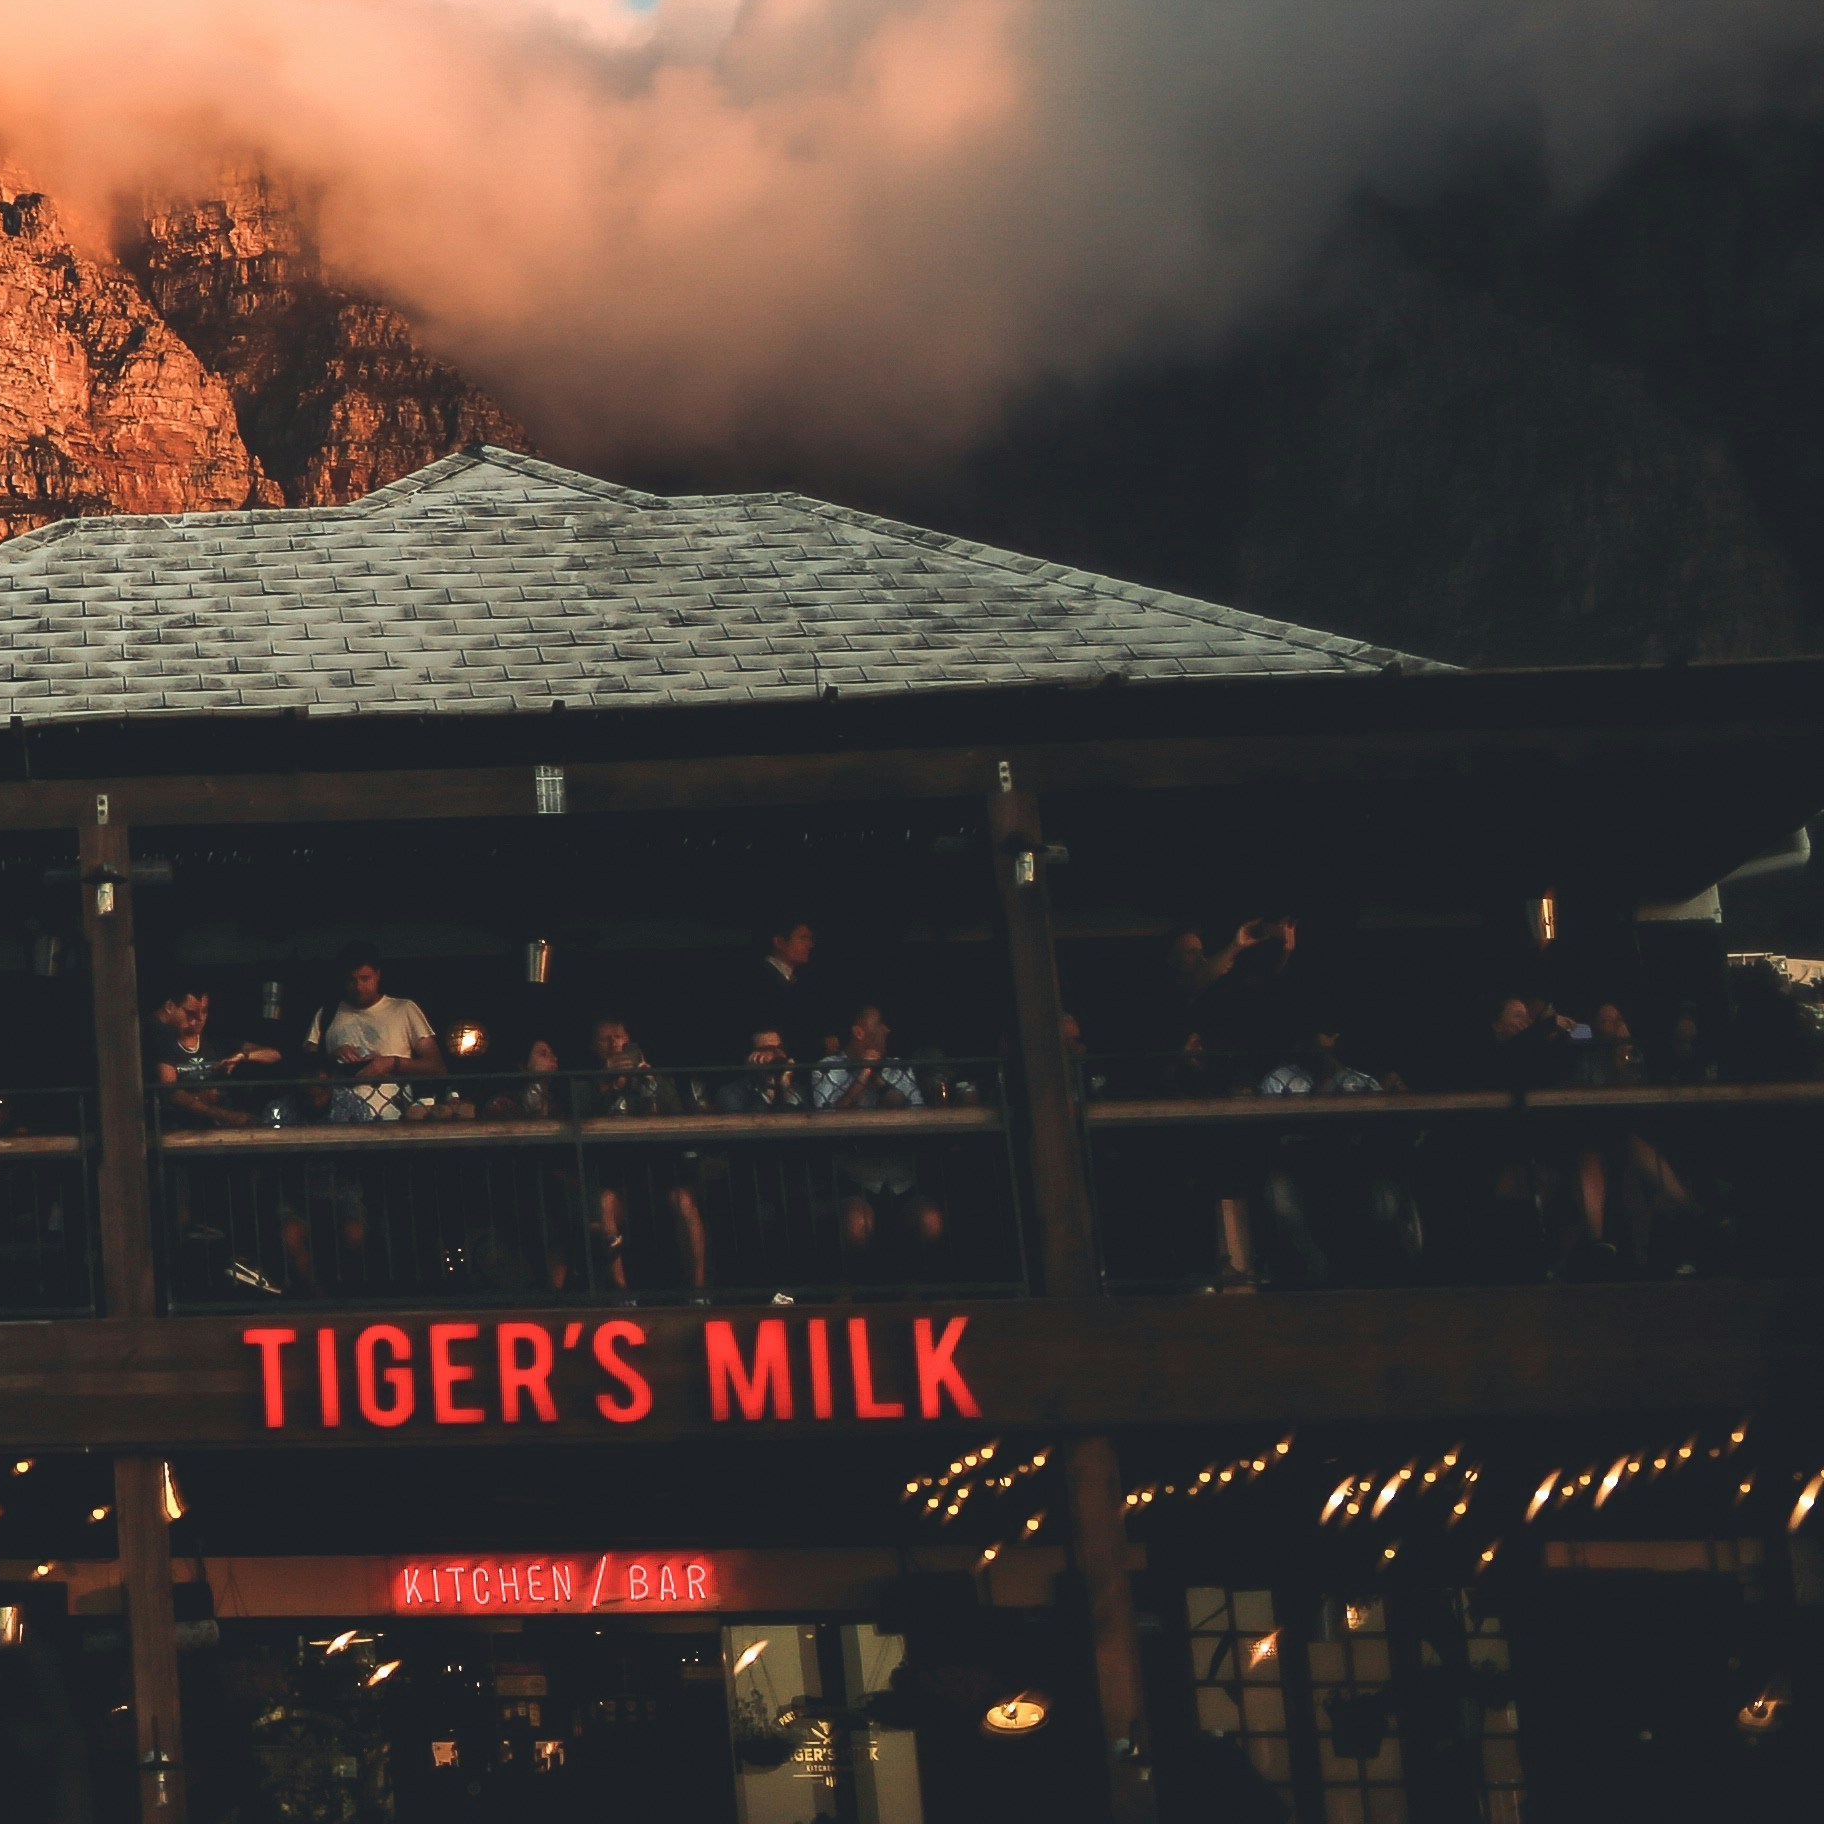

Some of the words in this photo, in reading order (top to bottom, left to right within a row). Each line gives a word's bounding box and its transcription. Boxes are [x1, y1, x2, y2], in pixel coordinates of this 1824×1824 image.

[243, 1319, 654, 1428] TIGER'S
[704, 1316, 984, 1422] MILK
[403, 1565, 573, 1606] KITCHEN
[629, 1564, 709, 1602] BAR
